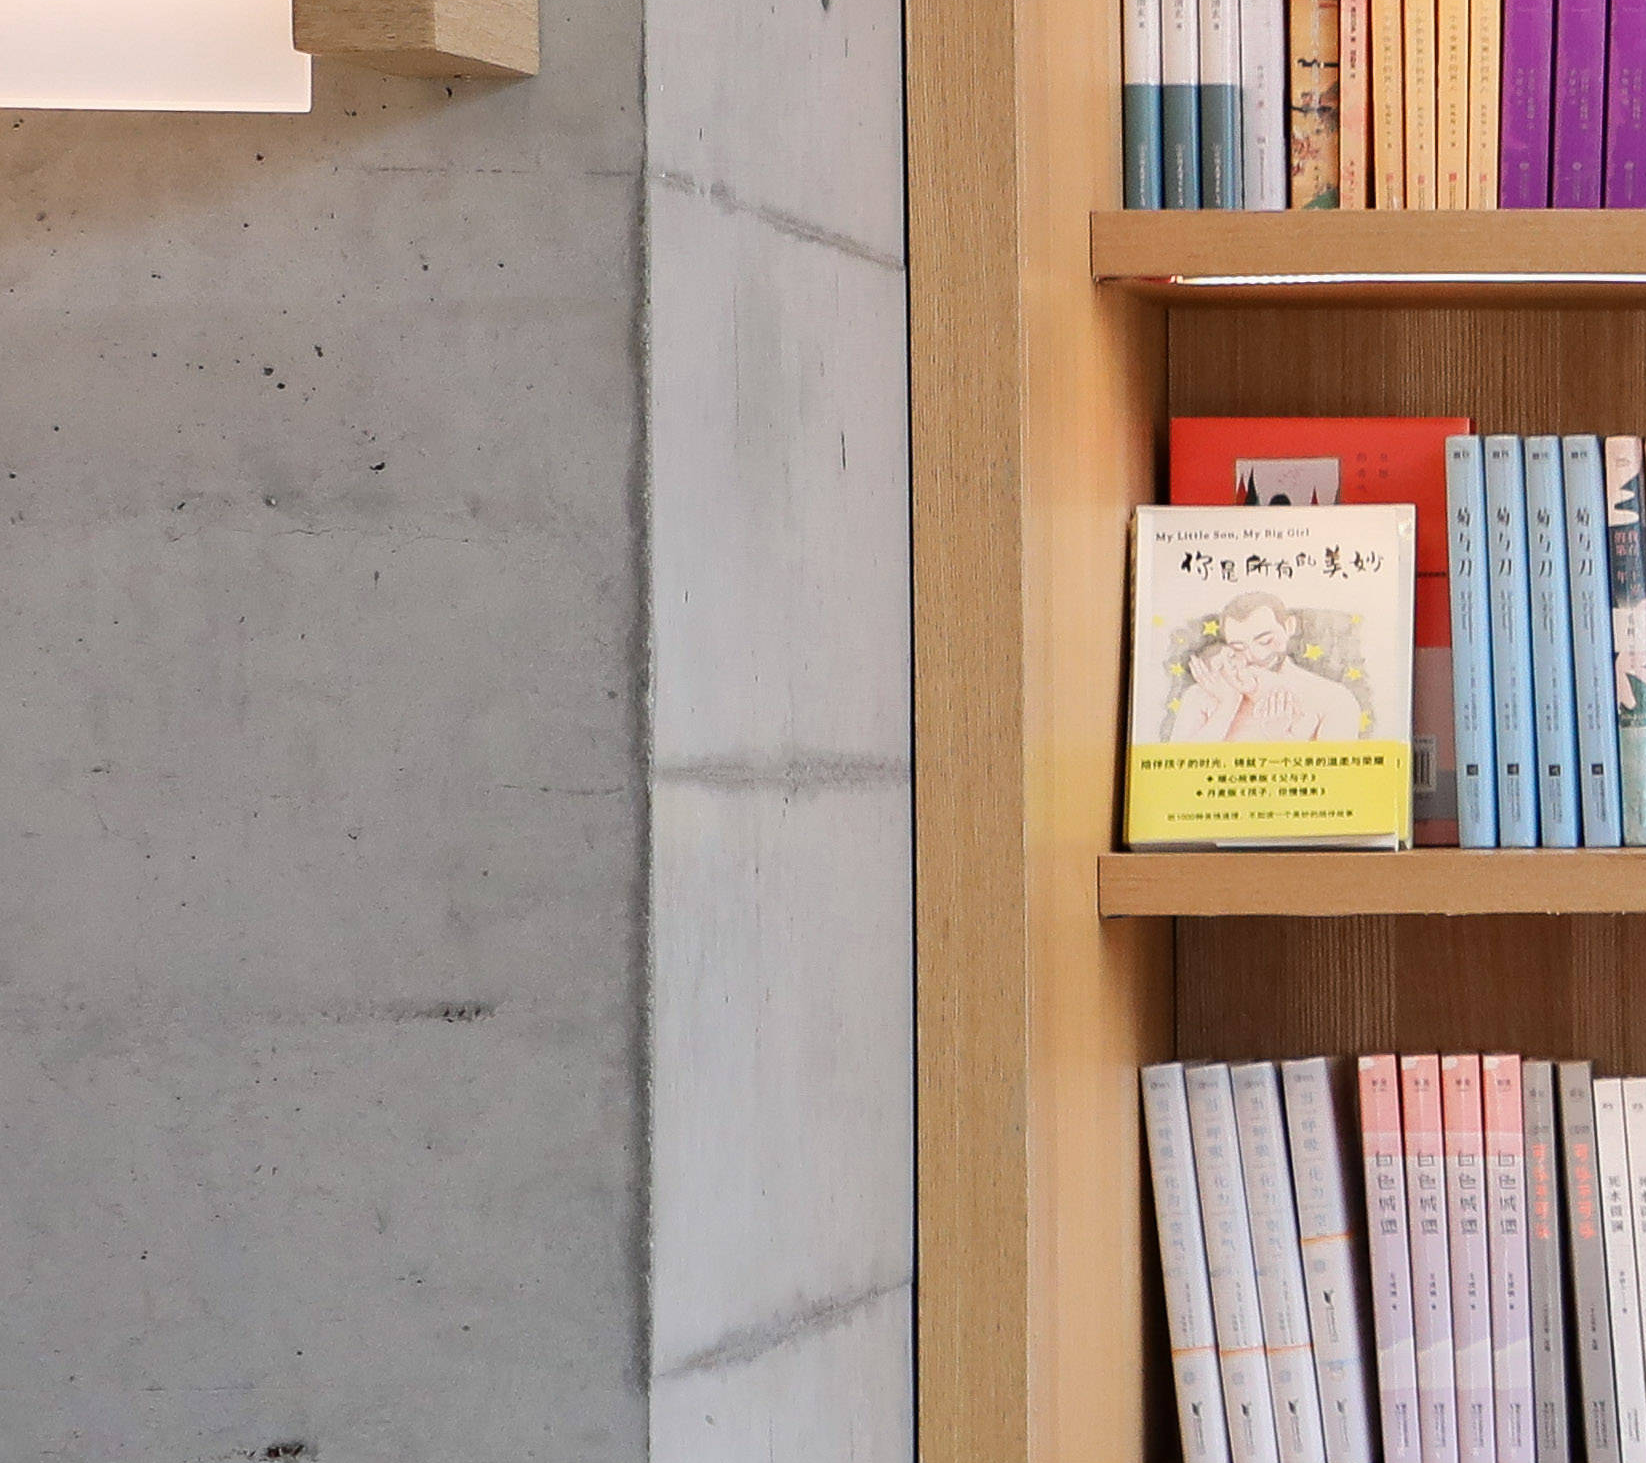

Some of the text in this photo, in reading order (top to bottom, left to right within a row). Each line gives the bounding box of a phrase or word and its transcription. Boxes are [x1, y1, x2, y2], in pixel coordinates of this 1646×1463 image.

[1177, 531, 1210, 541] Little
[1180, 544, 1385, 583] 你是所有的美妙
